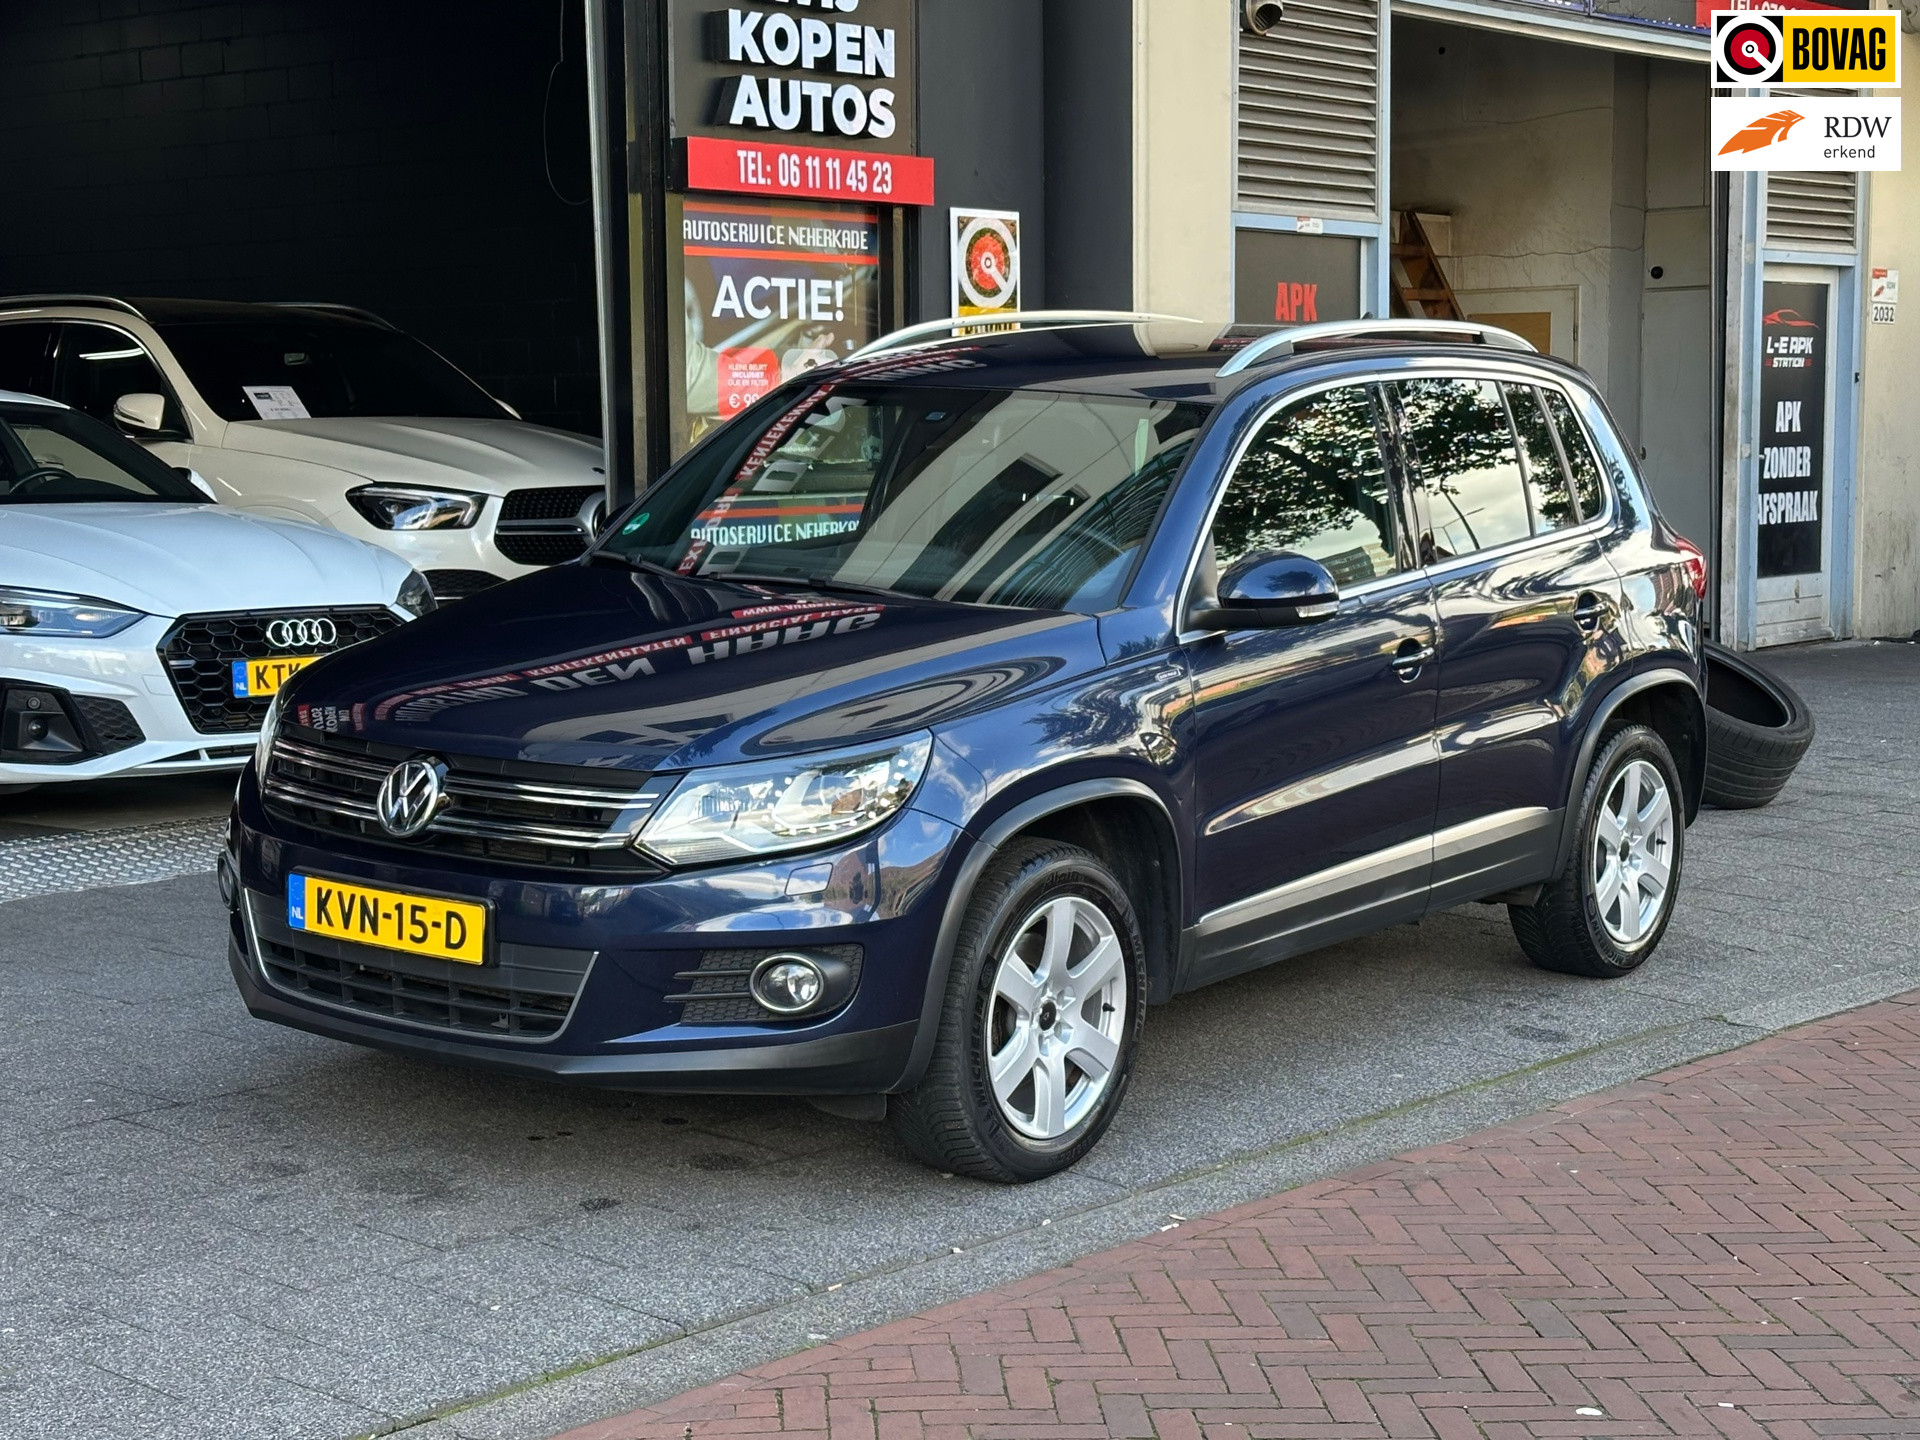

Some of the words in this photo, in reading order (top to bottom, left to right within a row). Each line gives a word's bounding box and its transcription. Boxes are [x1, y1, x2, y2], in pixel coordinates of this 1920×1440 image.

[728, 8, 896, 78] KOPEN
[729, 74, 896, 139] AUTOS
[737, 150, 772, 185] TEL:
[778, 153, 800, 188] 06
[805, 156, 821, 188] 11
[825, 158, 841, 190] 11
[846, 160, 868, 192] 45
[872, 161, 893, 195] 23
[683, 219, 785, 246] AUTOSERVICE
[788, 226, 868, 250] NEHERKADE
[711, 275, 844, 322] ACTIE!
[1275, 282, 1317, 322] APK
[1873, 306, 1895, 322] 2032
[1766, 336, 1789, 354] L-E
[1789, 336, 1814, 355] APK
[1772, 357, 1805, 368] STATION
[729, 393, 741, 409] €
[1775, 401, 1801, 433] APK
[1763, 446, 1811, 479] ZONDER
[291, 906, 304, 920] NL
[316, 887, 467, 950] KVN-15-D
